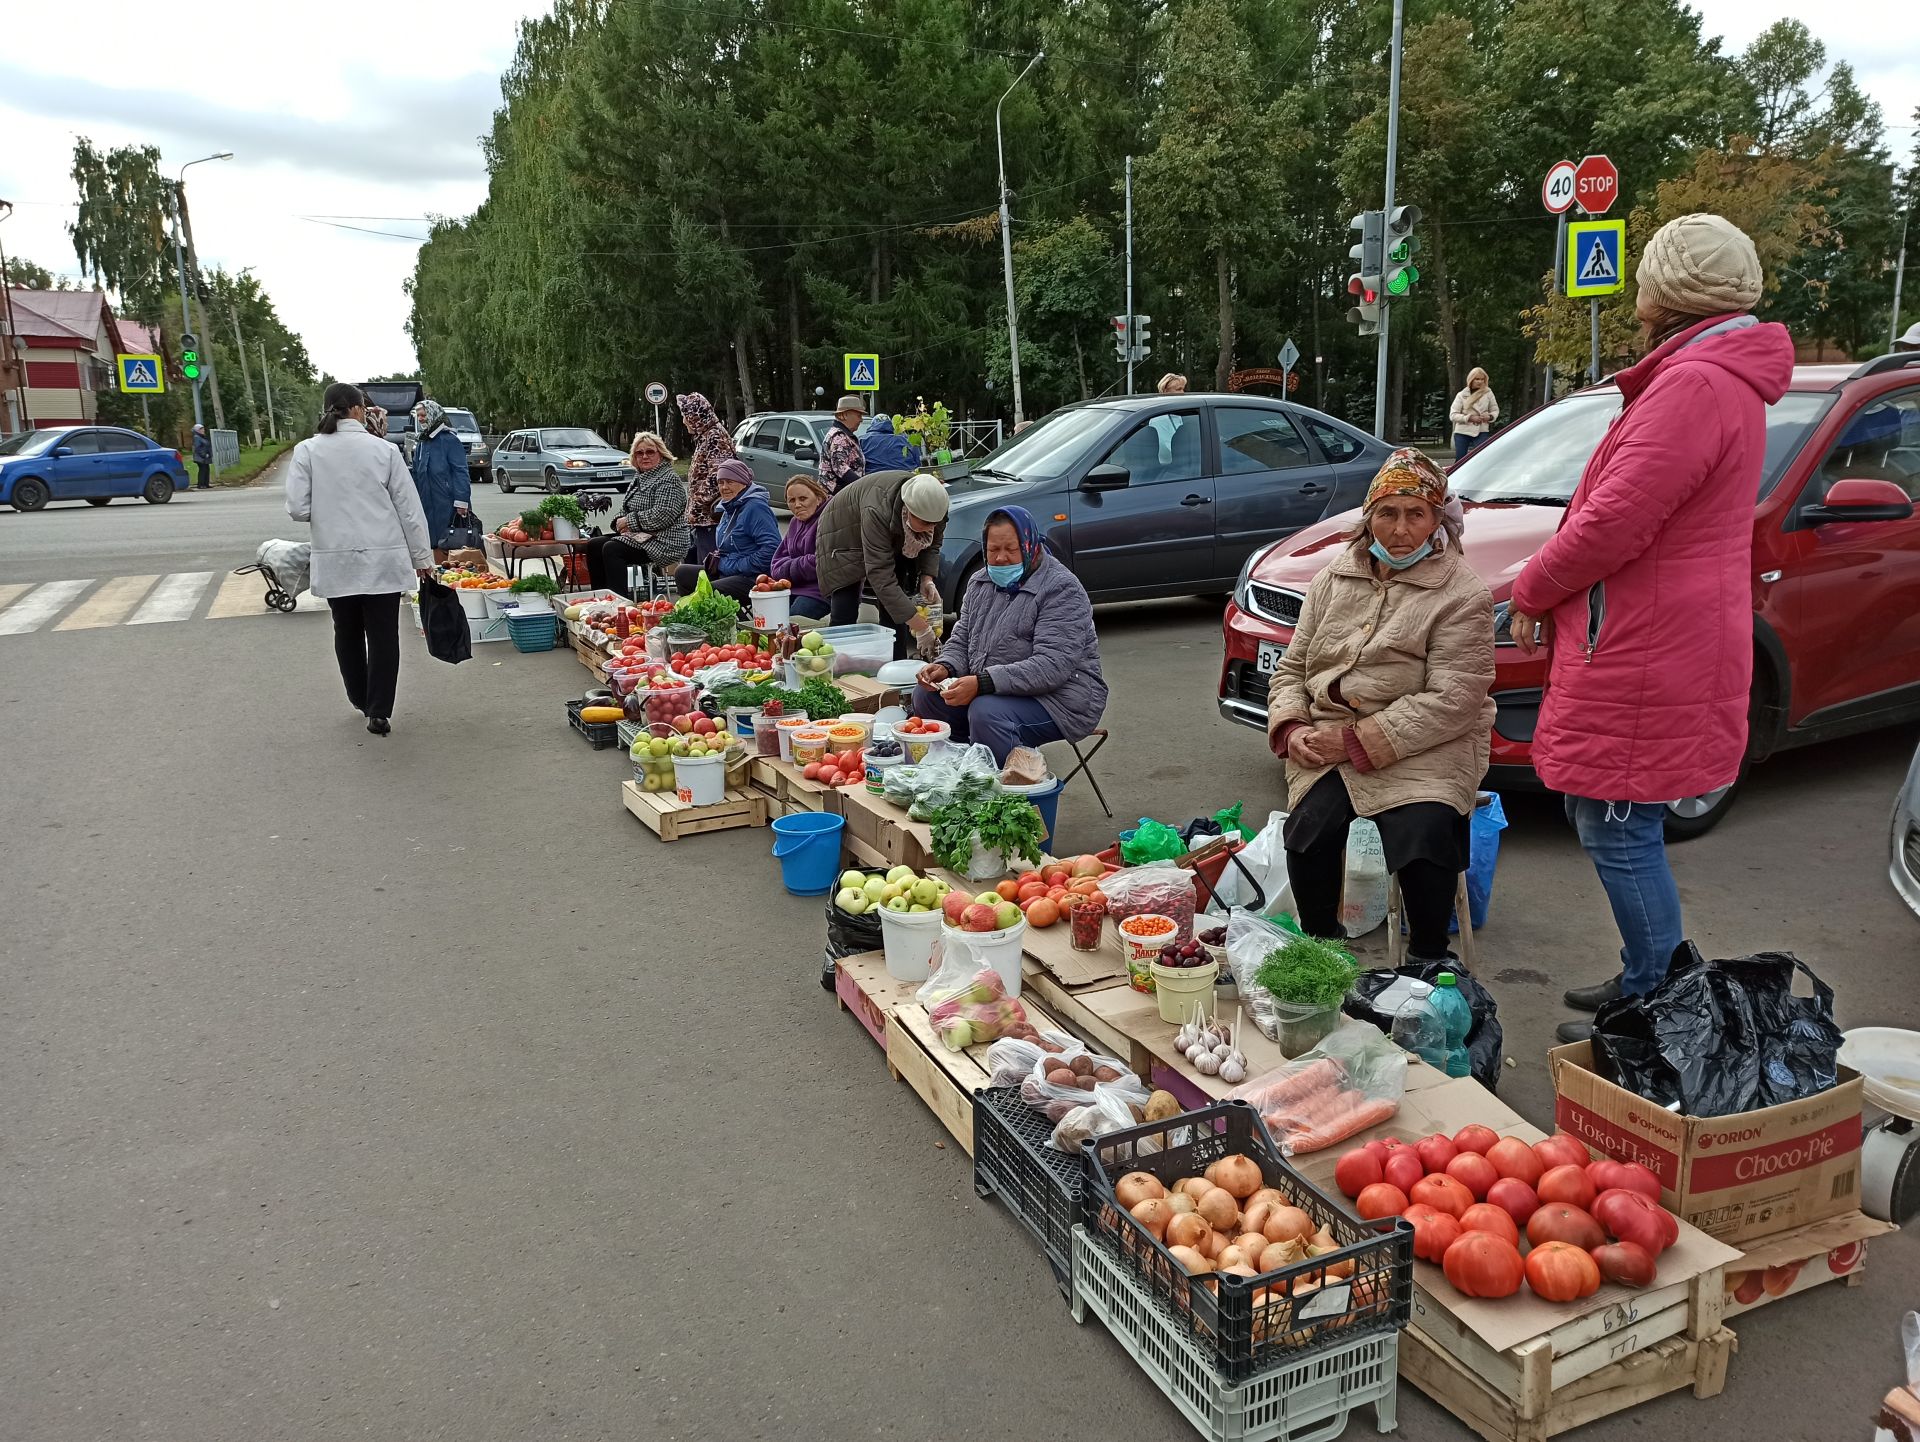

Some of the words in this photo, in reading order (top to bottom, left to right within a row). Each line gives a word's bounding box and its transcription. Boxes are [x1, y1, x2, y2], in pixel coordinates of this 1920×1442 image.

[1550, 175, 1572, 198] 40
[1579, 176, 1614, 193] STOP
[184, 351, 197, 361] 20
[1640, 1119, 1678, 1143] ОРИОН
[1717, 1128, 1762, 1145] ORION
